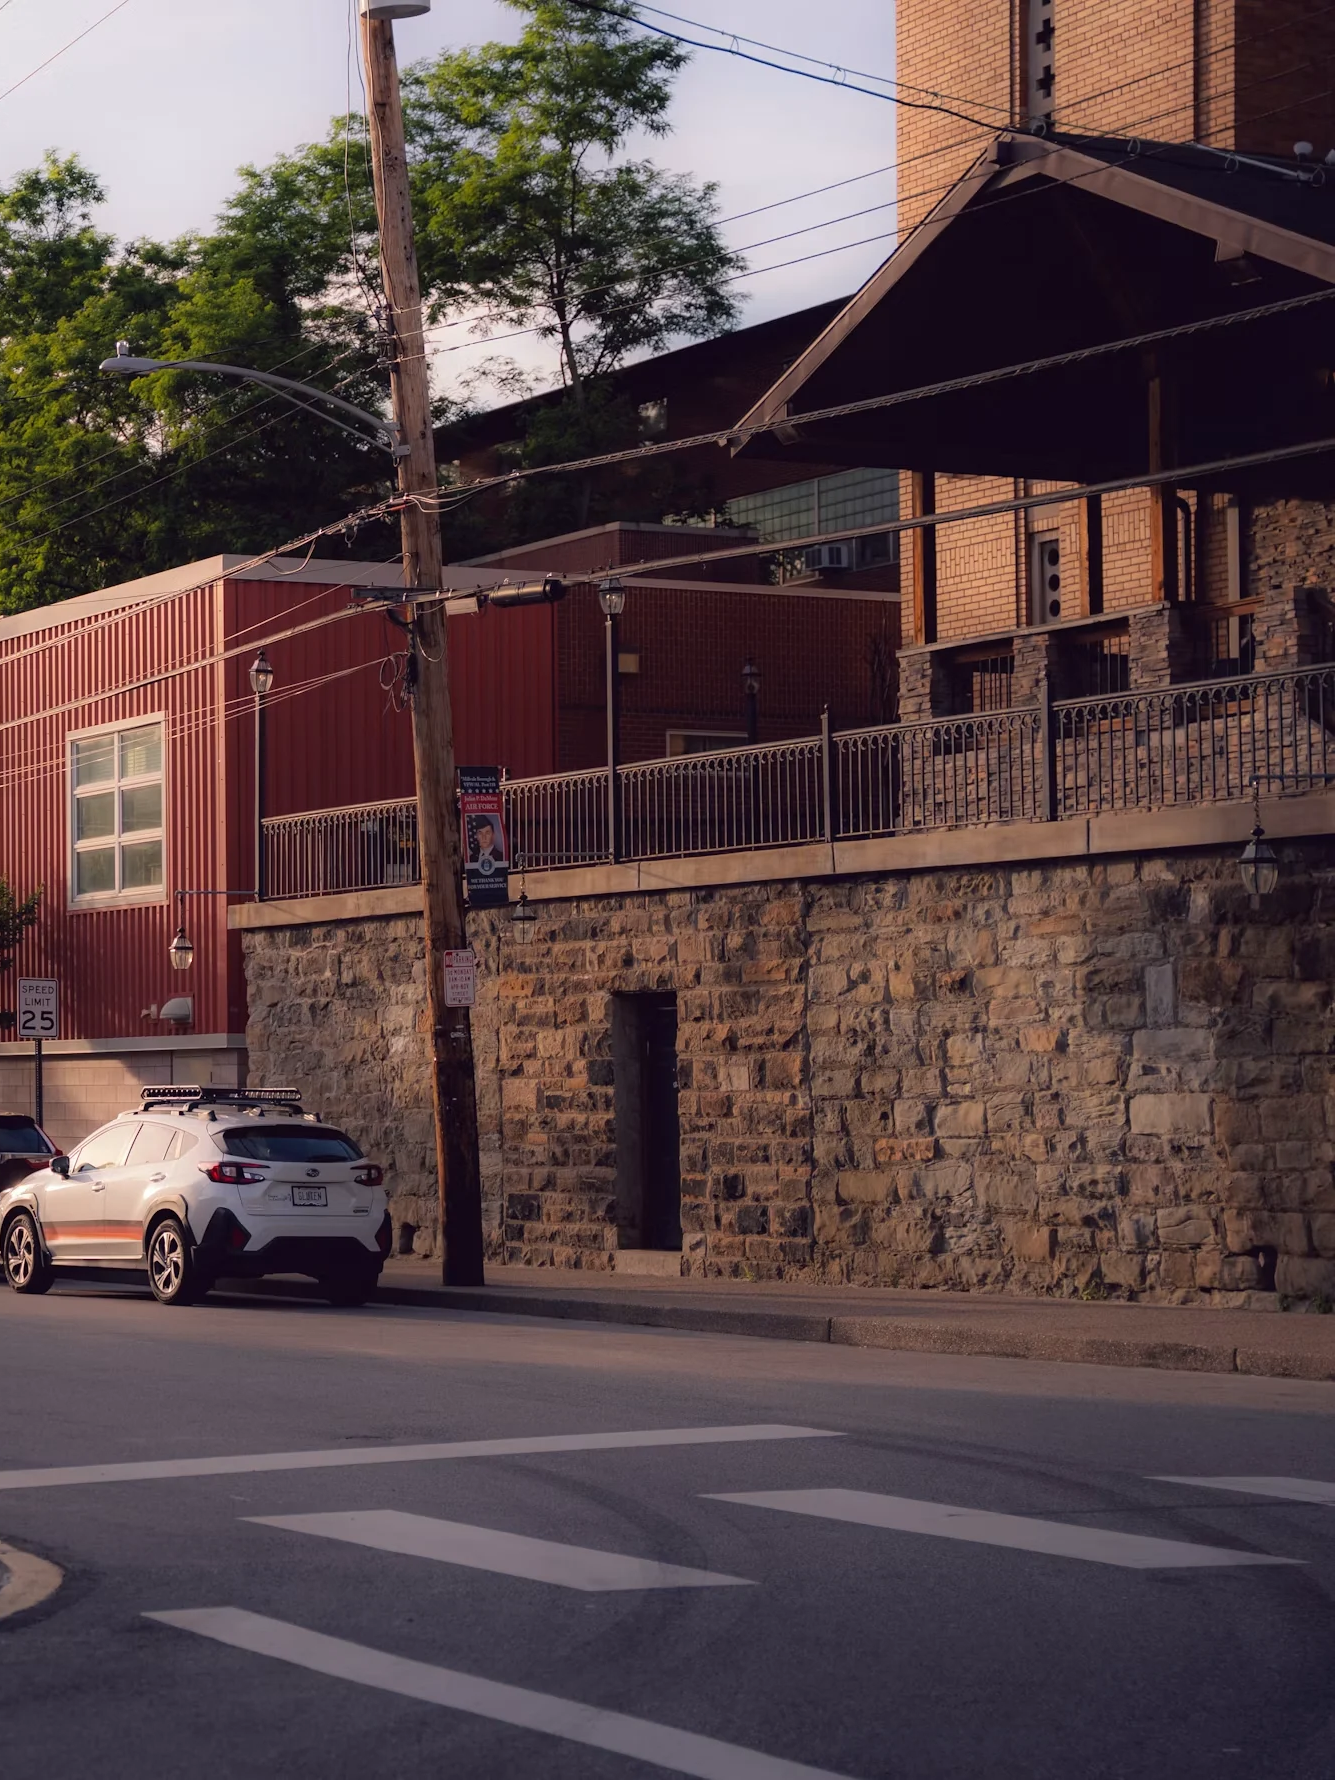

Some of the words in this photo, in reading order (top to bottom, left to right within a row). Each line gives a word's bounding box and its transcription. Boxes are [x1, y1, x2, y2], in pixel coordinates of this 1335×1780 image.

[478, 803, 499, 811] FORCE
[453, 955, 473, 963] PARKING
[22, 985, 54, 994] SPEED
[24, 998, 51, 1007] LIMIT
[22, 1010, 55, 1031] 25
